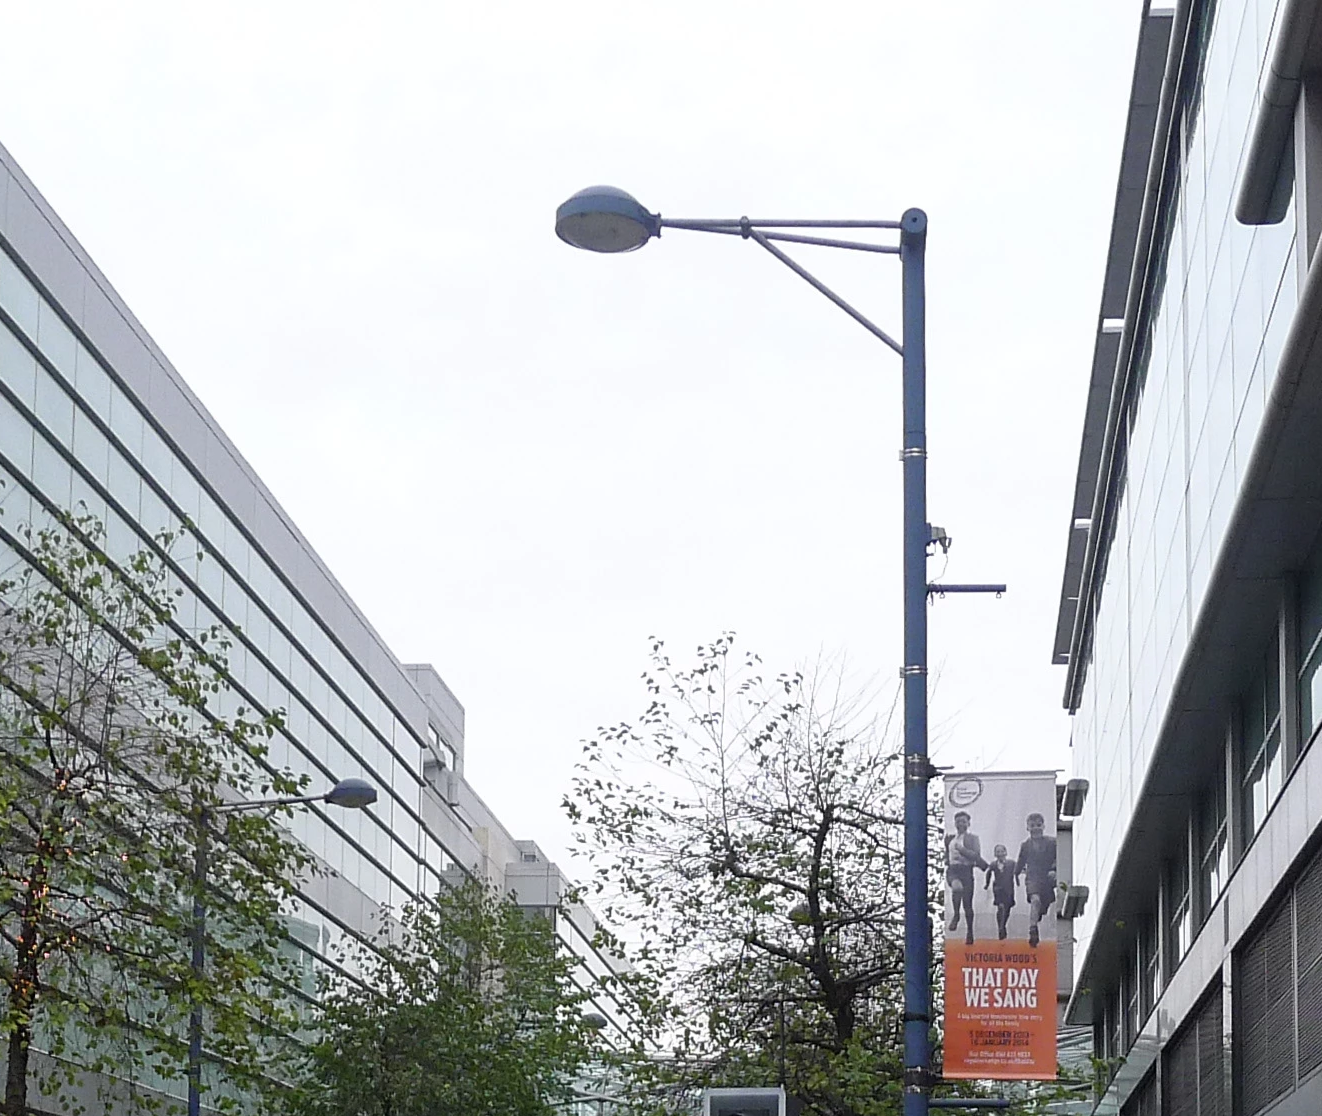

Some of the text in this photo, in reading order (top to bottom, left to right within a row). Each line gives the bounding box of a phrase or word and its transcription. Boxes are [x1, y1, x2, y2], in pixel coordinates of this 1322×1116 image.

[964, 953, 1038, 963] VICTORIA WOOD'S
[962, 967, 1039, 988] THAT DAY
[965, 988, 1037, 1008] WE SANG
